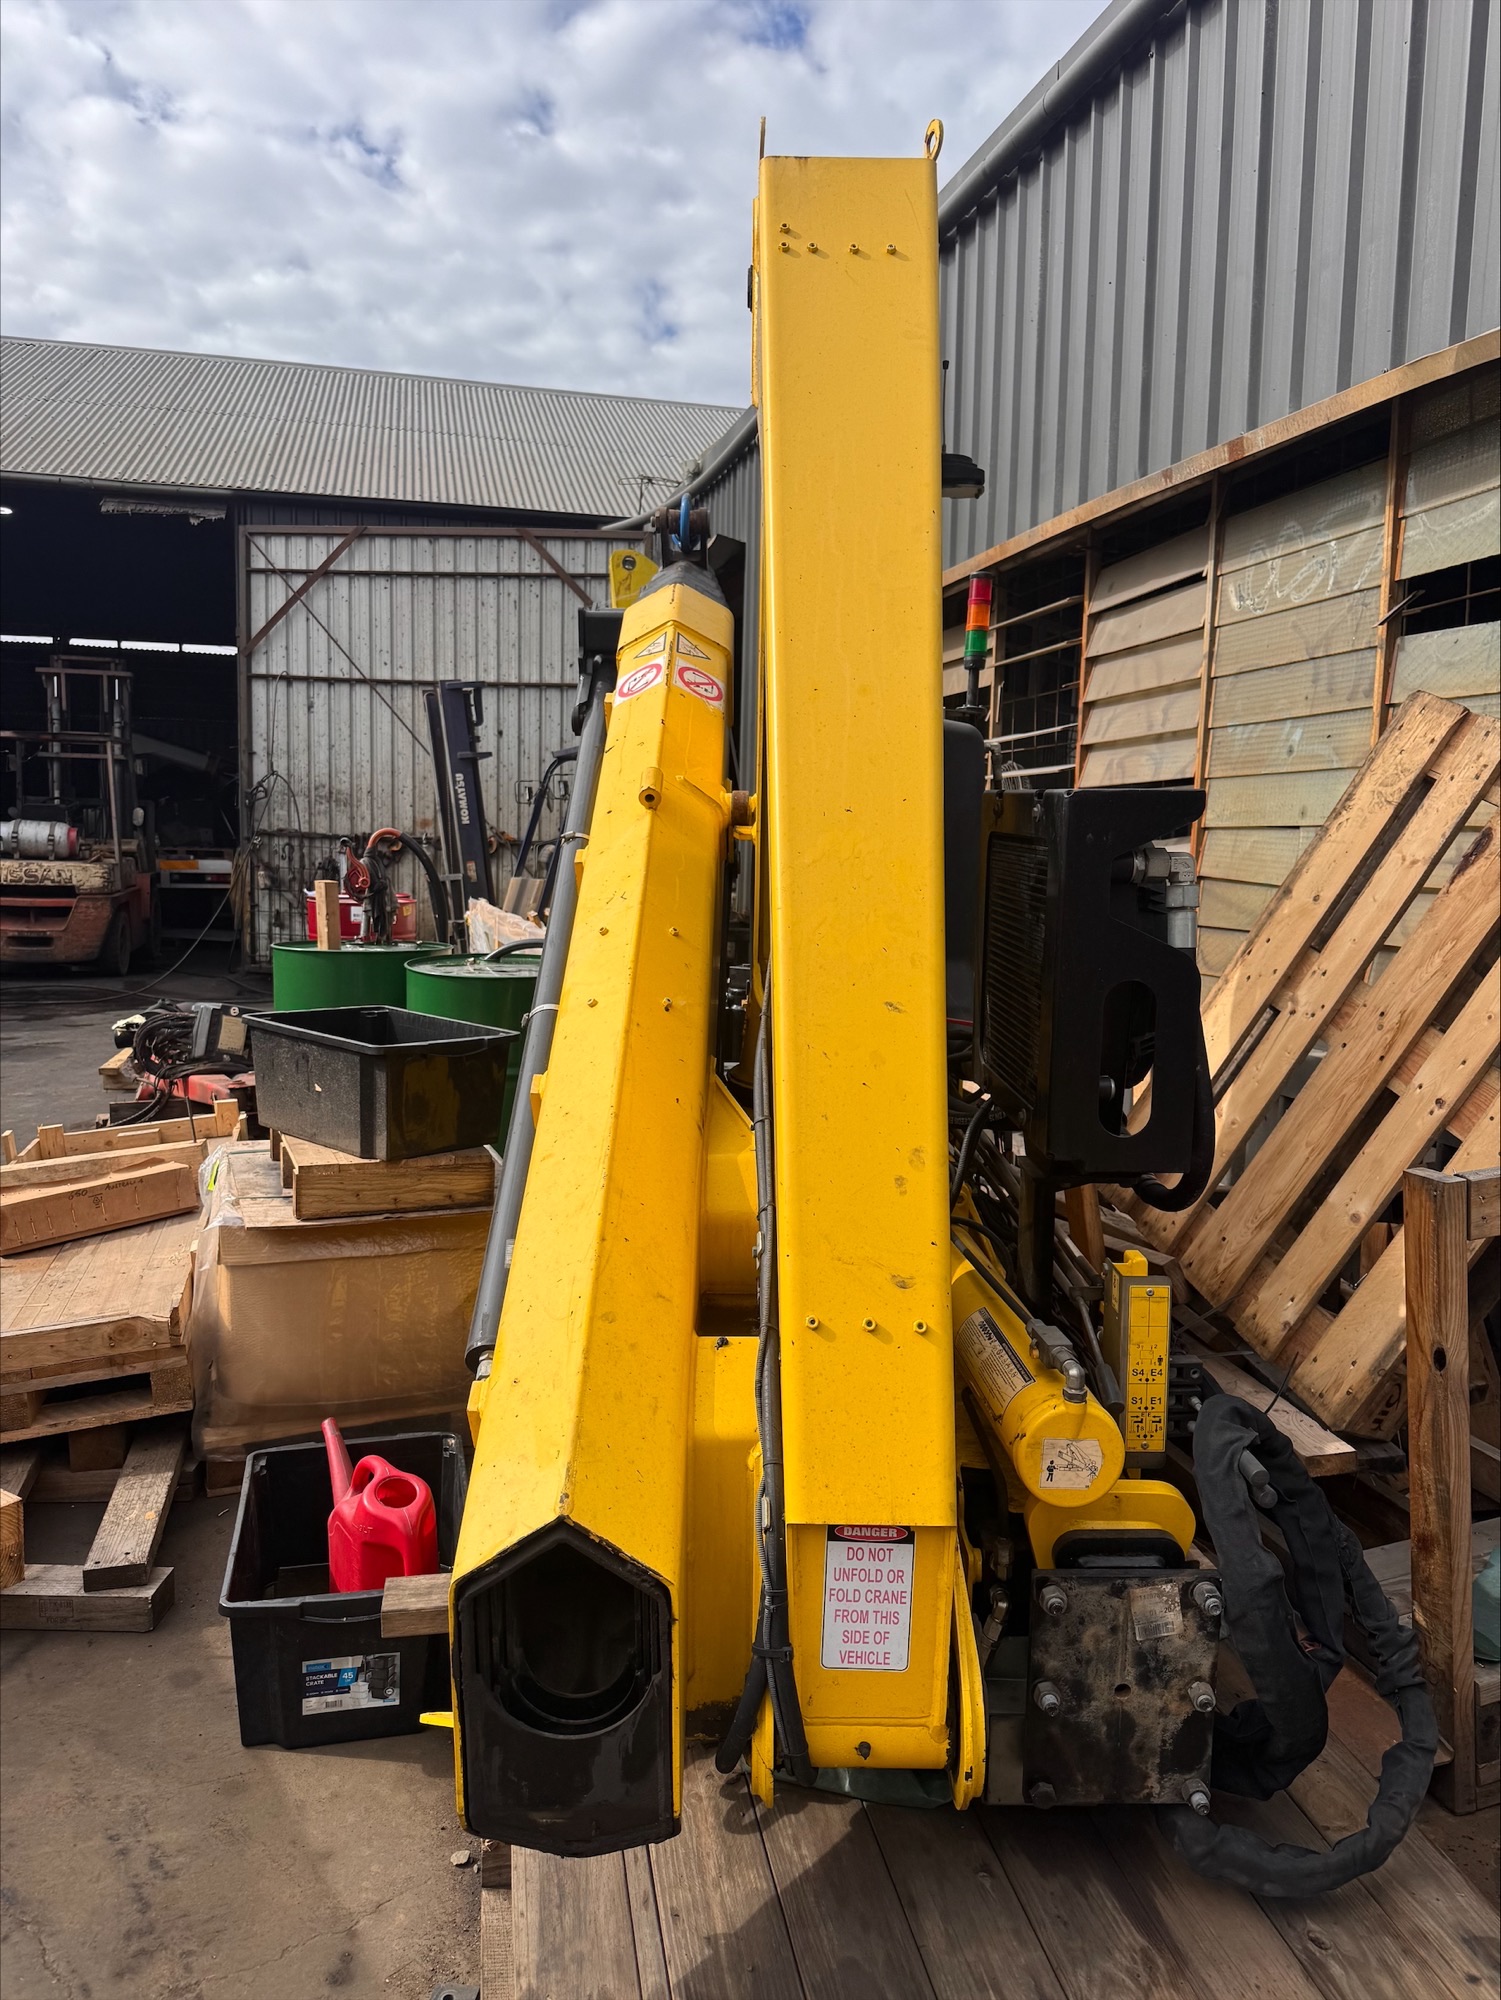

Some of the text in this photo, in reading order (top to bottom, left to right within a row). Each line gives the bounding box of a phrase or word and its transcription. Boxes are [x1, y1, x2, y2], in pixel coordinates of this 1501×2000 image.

[455, 773, 470, 825] KOMATSU
[0, 868, 73, 884] ISSAN
[1132, 1368, 1163, 1377] S4 E4
[1130, 1396, 1162, 1405] S1 E1
[843, 1526, 898, 1538] DANGER
[846, 1546, 894, 1563] DO NOT
[833, 1567, 905, 1584] UNFOLD OR
[828, 1588, 908, 1605] FOLD CRANE
[834, 1609, 900, 1625] FROM THIS
[842, 1629, 890, 1645] SIDE OF
[839, 1650, 891, 1666] VEHICLE
[305, 1672, 338, 1682] STACKABLE
[342, 1671, 354, 1679] 45
